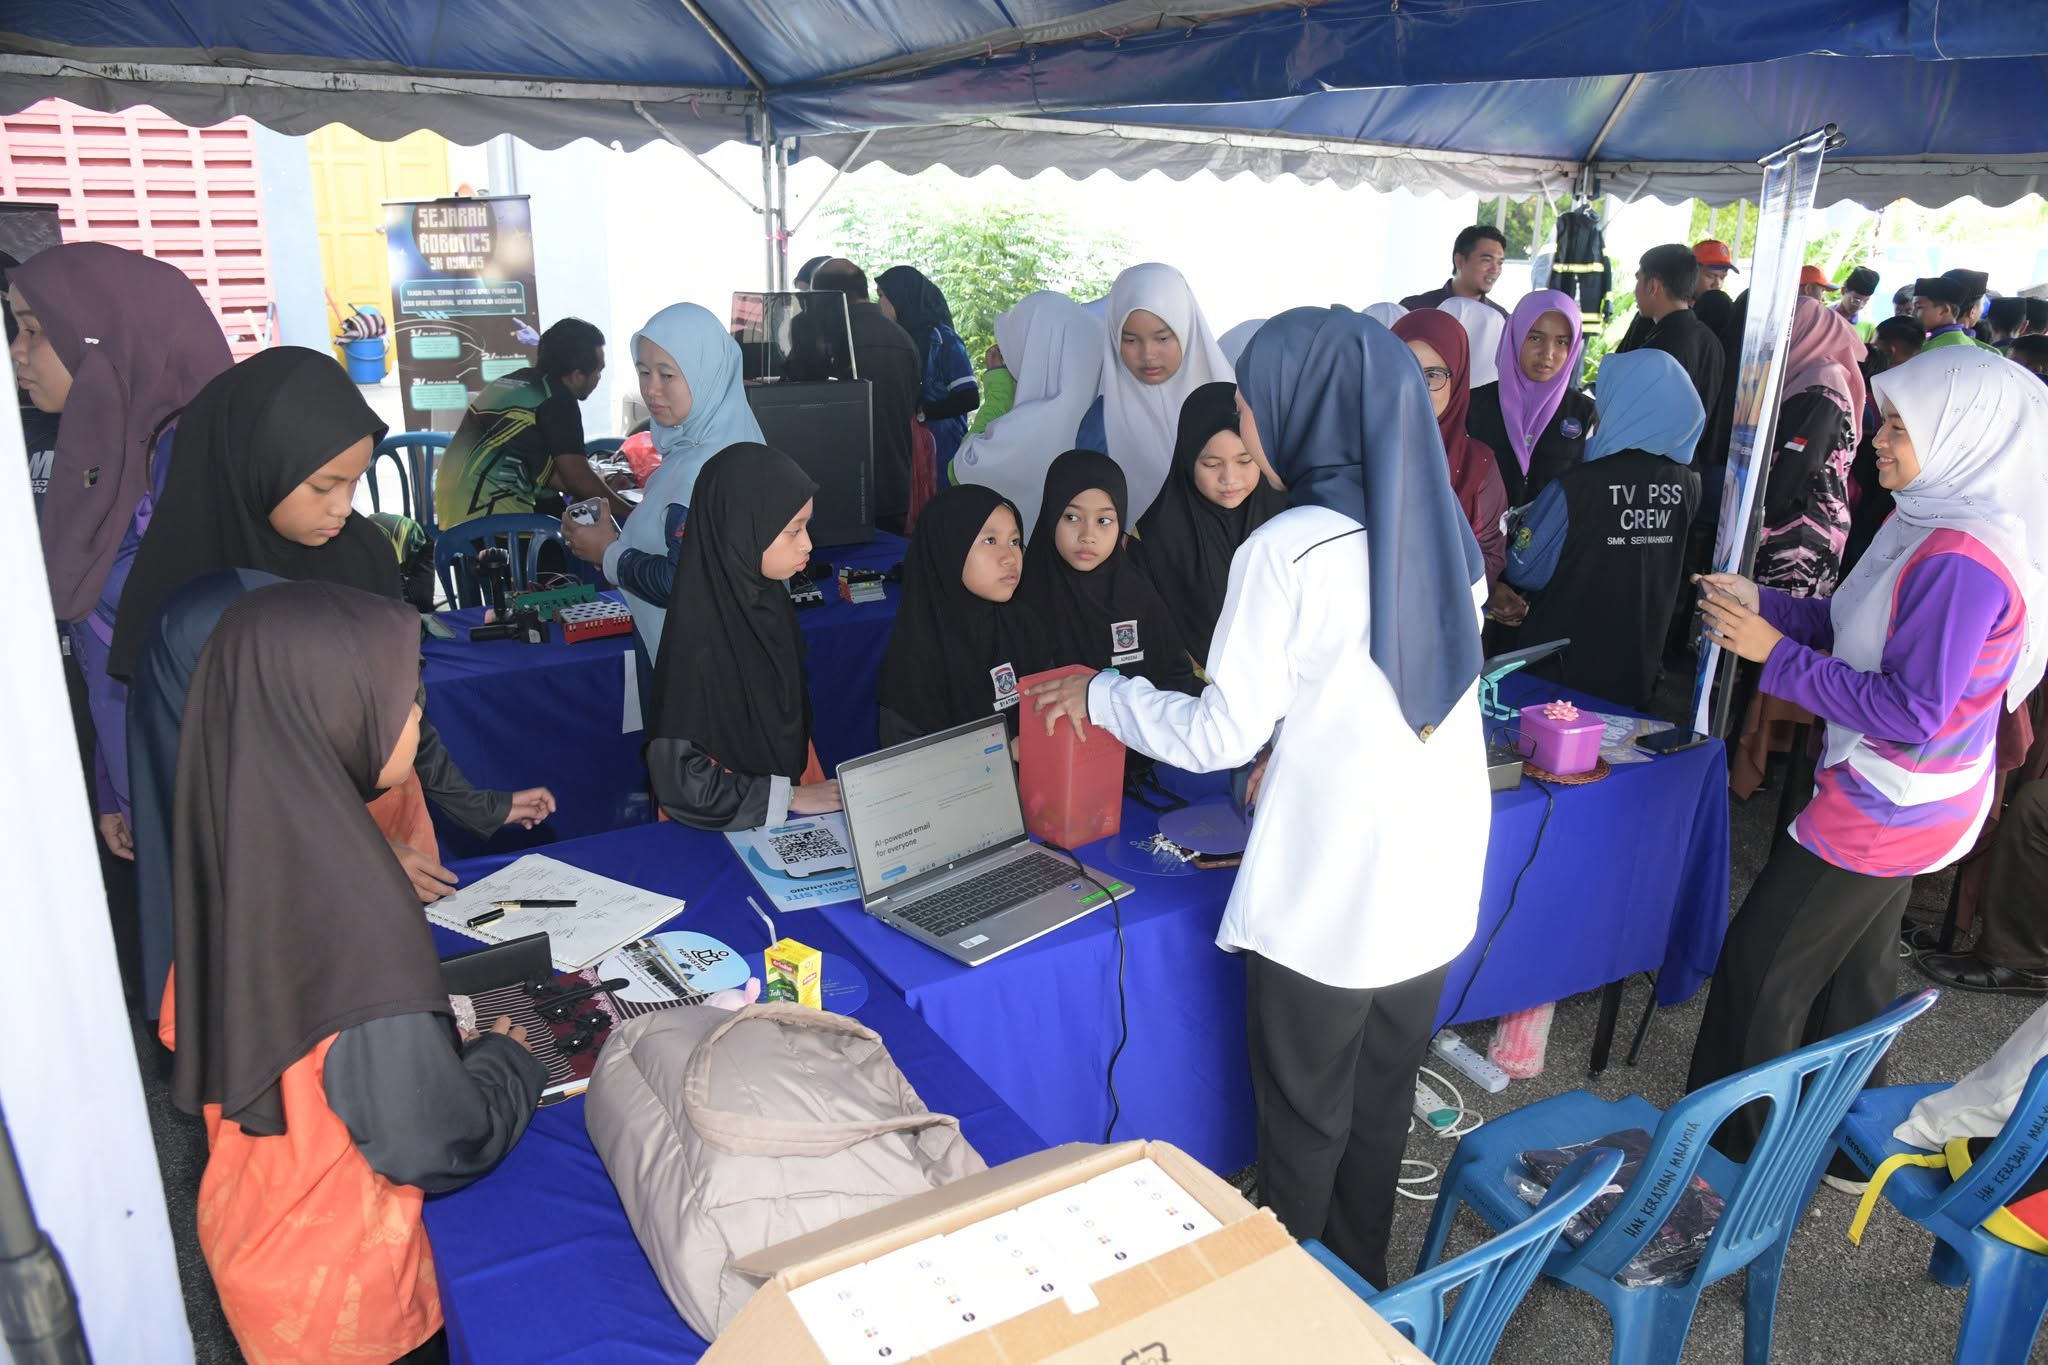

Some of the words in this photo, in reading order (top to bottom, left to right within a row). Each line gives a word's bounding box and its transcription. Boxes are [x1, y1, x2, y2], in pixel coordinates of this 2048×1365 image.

[418, 207, 487, 228] SEJARAH
[419, 233, 491, 254] ROBOTICS
[430, 257, 443, 270] SK
[1608, 484, 1637, 505] TV
[1648, 483, 1683, 505] PSS
[1620, 508, 1672, 530] CREW
[1607, 536, 1626, 545] SMK
[1630, 536, 1647, 545] SERI
[1647, 535, 1673, 544] MAHKOTA
[874, 828, 913, 848] AI-powered
[913, 821, 931, 834] email
[876, 849, 887, 858] for
[887, 838, 917, 854] everyone
[784, 892, 813, 902] SITE
[815, 883, 859, 896] OOGLE
[1623, 1217, 1647, 1239] HAK
[1640, 1169, 1677, 1218] KERAJAAN
[1670, 1121, 1701, 1168] MALAYSIA
[1974, 1184, 1996, 1203] HAK
[1991, 1141, 2033, 1185] KERAJAAN
